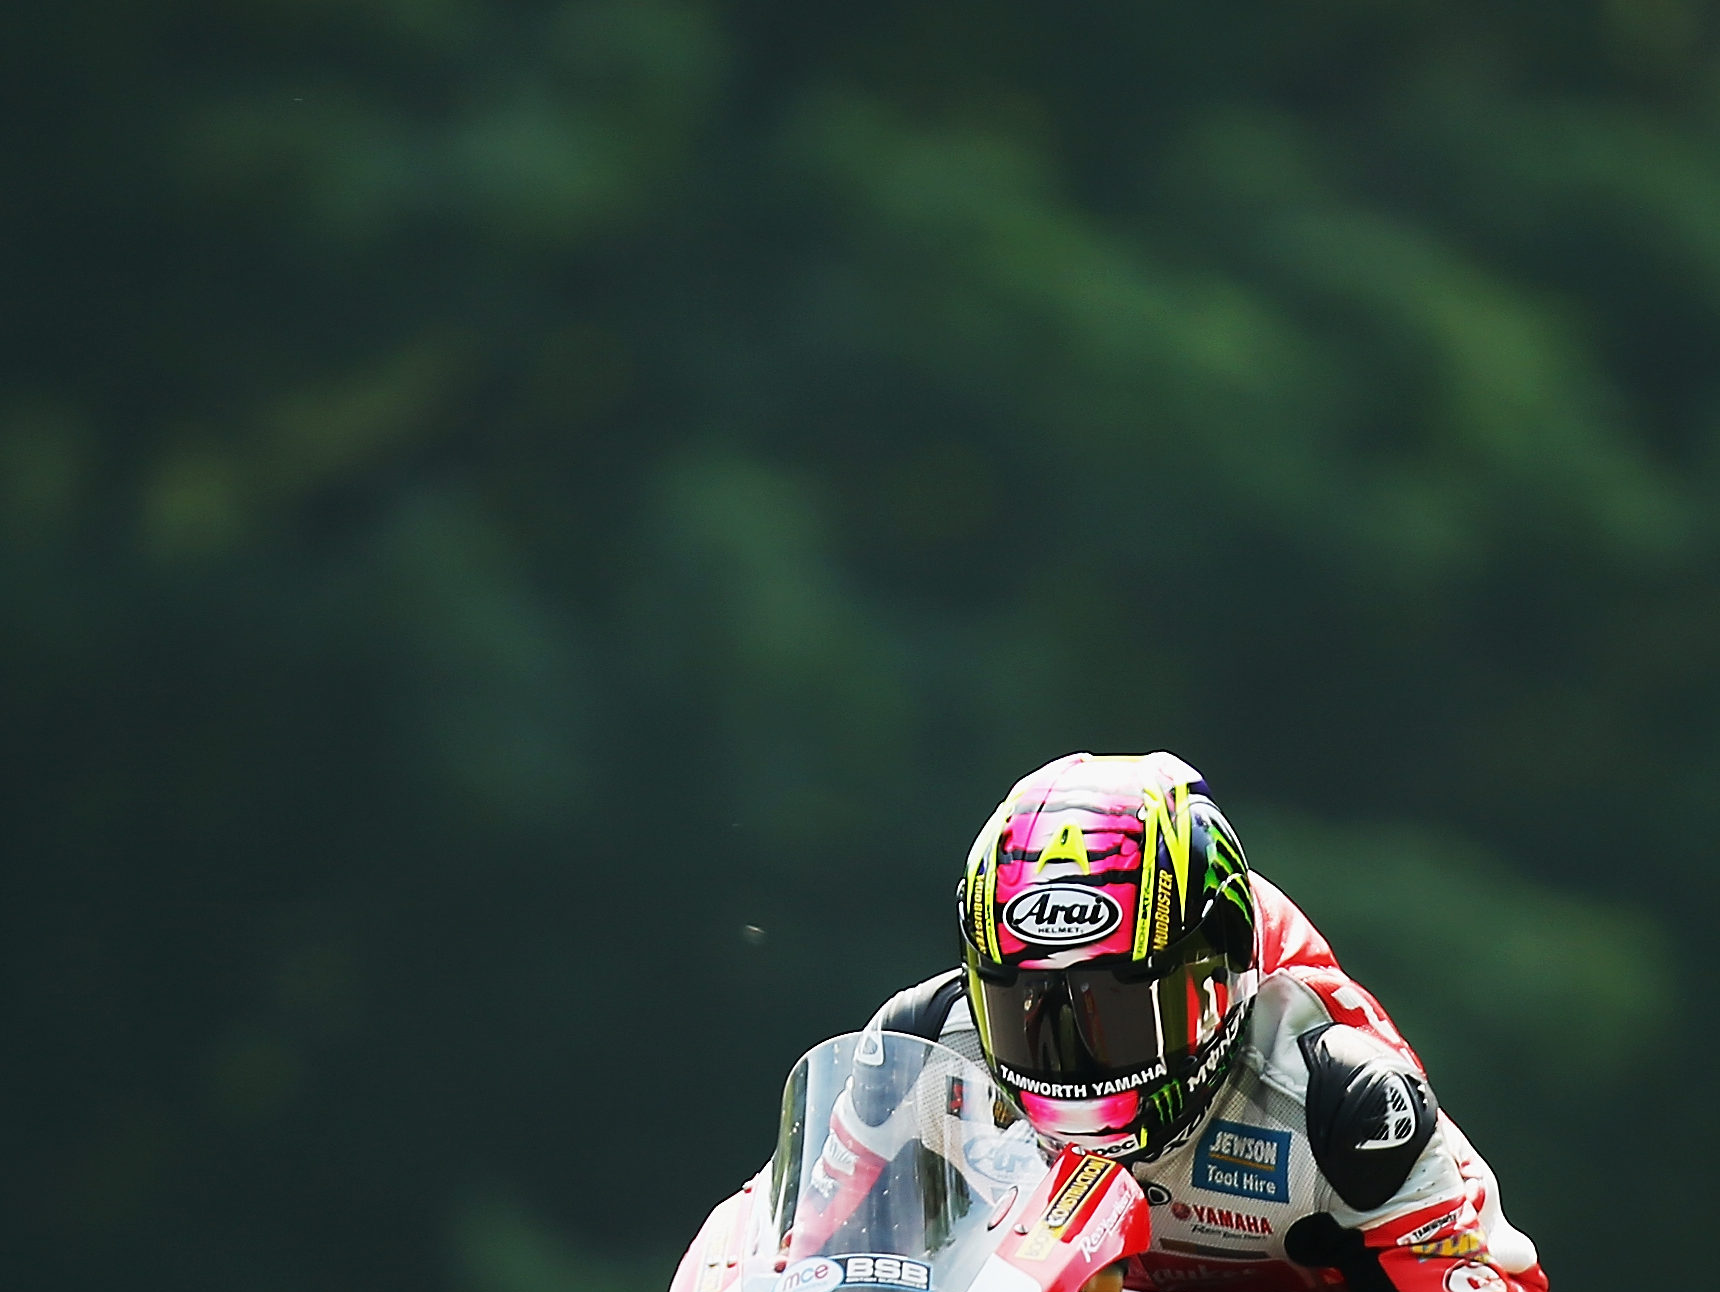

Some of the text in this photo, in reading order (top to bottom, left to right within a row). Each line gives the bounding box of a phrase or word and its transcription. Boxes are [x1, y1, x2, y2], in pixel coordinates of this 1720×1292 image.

[1012, 893, 1103, 926] Arai
[999, 1062, 1168, 1098] TAMWORTH YAMAHA
[1209, 1130, 1278, 1165] JEWSON
[1206, 1164, 1277, 1195] Tool Hire
[1192, 1203, 1274, 1235] YAMAHA
[782, 1263, 830, 1292] mce
[845, 1256, 929, 1285] BSB
